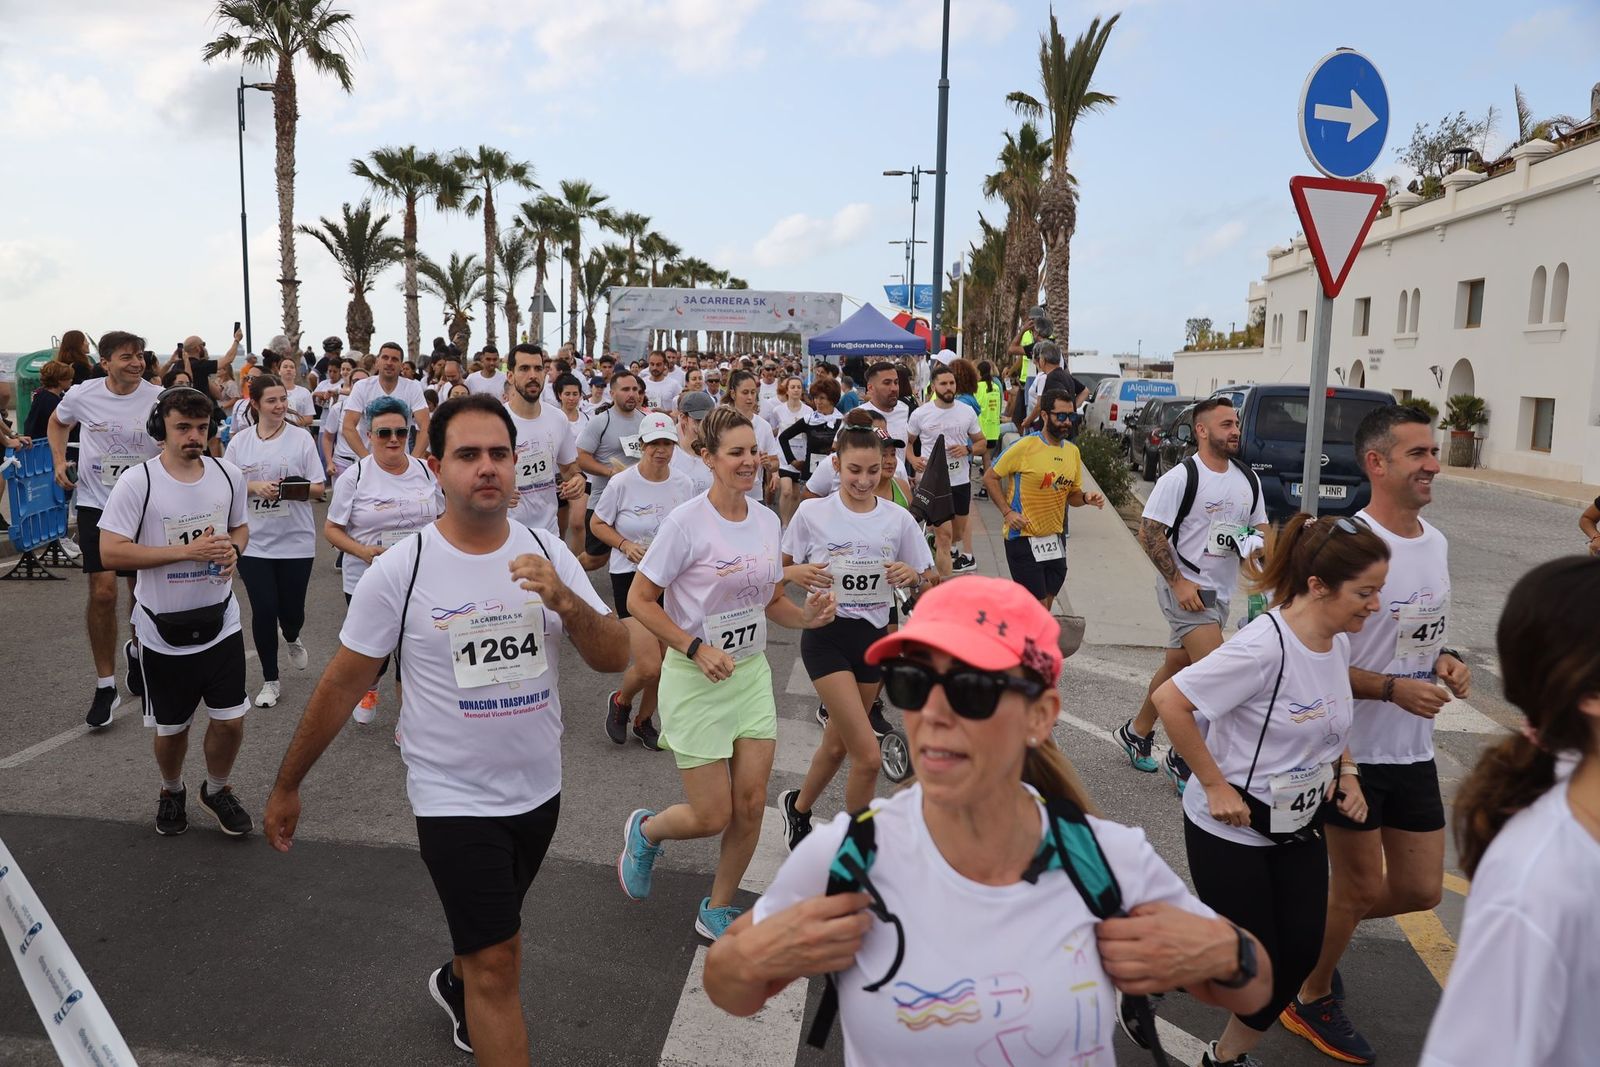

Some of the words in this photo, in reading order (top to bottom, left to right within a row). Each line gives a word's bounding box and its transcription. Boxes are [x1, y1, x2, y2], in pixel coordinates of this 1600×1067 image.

[683, 296, 697, 304] 3A
[700, 296, 750, 306] CARRERA
[753, 298, 766, 306] 5K
[522, 460, 546, 476] 213
[1326, 486, 1342, 496] HNR
[252, 500, 280, 510] 742
[1034, 542, 1058, 554] 1123
[842, 574, 880, 590] 687
[480, 614, 513, 623] CARRERA
[722, 623, 757, 650] 277
[1412, 616, 1445, 641] 473
[462, 632, 538, 666] 1264
[459, 698, 498, 710] DONACIÓN
[500, 693, 540, 708] TRASPLANTE
[1290, 782, 1325, 812] 421
